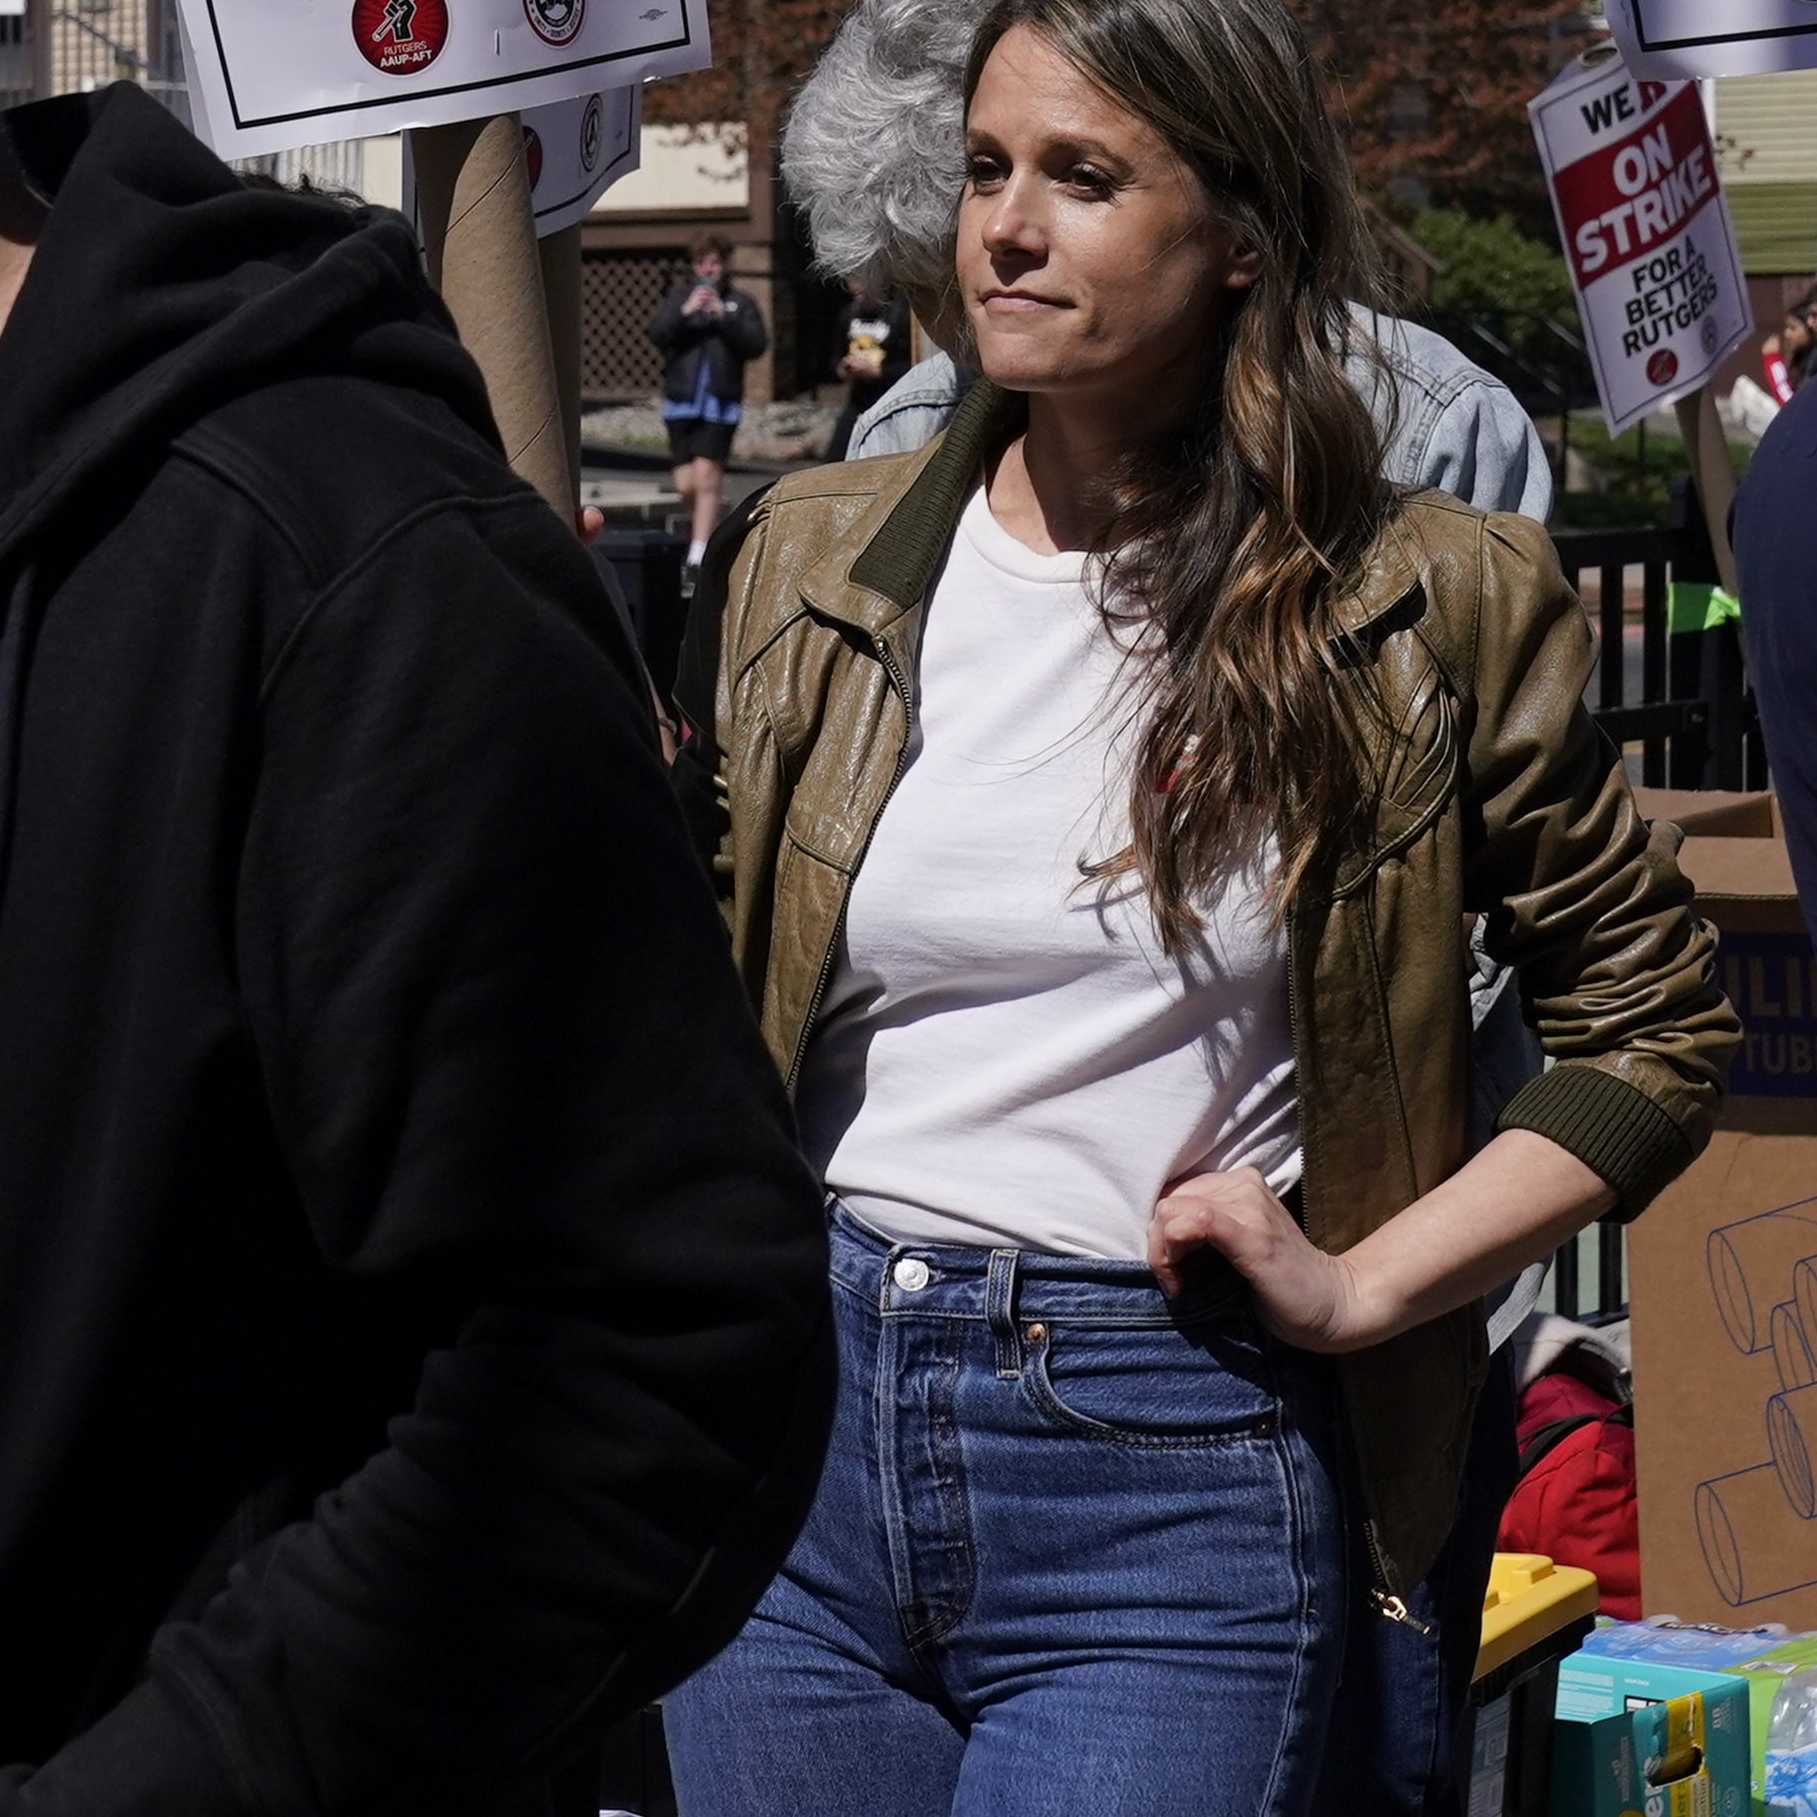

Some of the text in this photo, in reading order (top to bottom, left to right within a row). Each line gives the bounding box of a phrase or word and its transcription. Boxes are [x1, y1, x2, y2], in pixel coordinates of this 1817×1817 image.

[380, 50, 433, 68] AAUP-AFT
[384, 41, 428, 56] RUTGERS
[1580, 84, 1635, 135] WE
[1612, 123, 1674, 197] ON
[1575, 143, 1712, 274] STRIKE
[1624, 254, 1708, 327] BETTER
[1632, 235, 1696, 294] FOR A
[1622, 275, 1719, 359] RUTGERS
